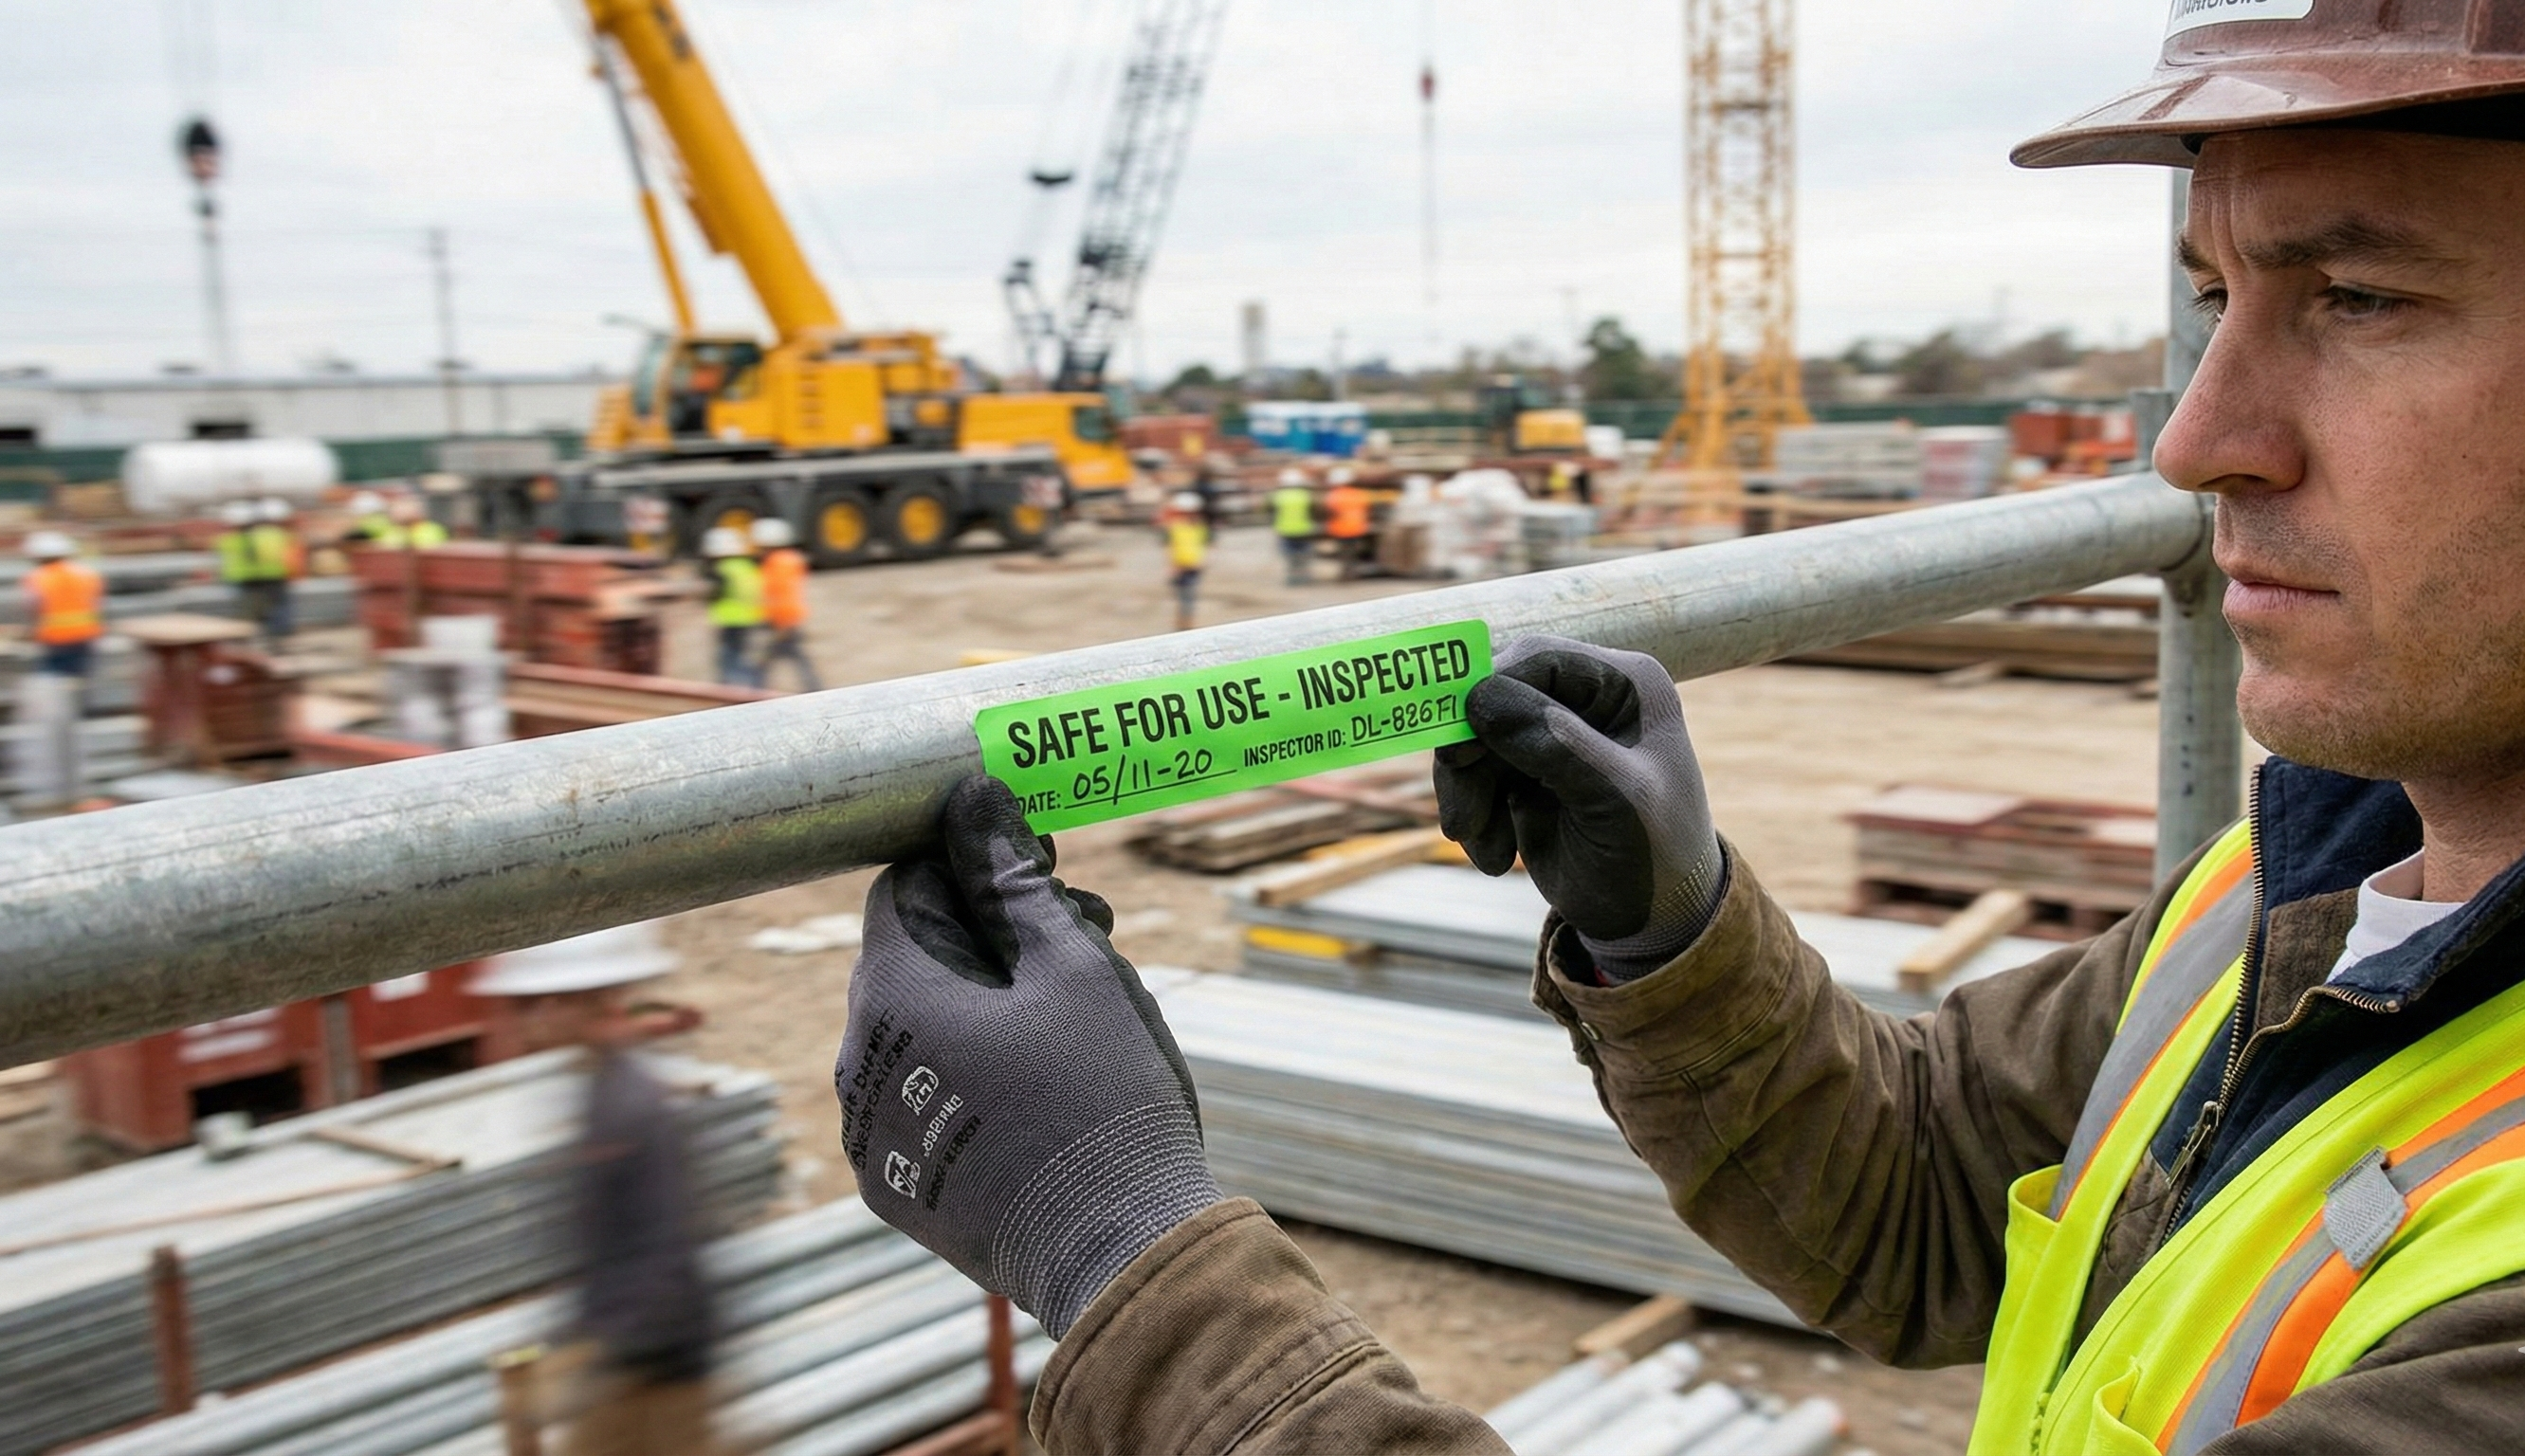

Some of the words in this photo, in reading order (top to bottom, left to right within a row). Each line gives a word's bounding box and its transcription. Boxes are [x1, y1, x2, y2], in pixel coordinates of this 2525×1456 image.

[1008, 708, 1108, 768] SAFE
[1114, 693, 1192, 747] FOR
[1197, 677, 1270, 730] USE
[1278, 692, 1290, 701] -
[1297, 639, 1470, 710] INSPECTED
[1244, 733, 1324, 767] INSPECTOR
[1327, 730, 1346, 749] ID:
[1073, 750, 1213, 806] 05/11-20
